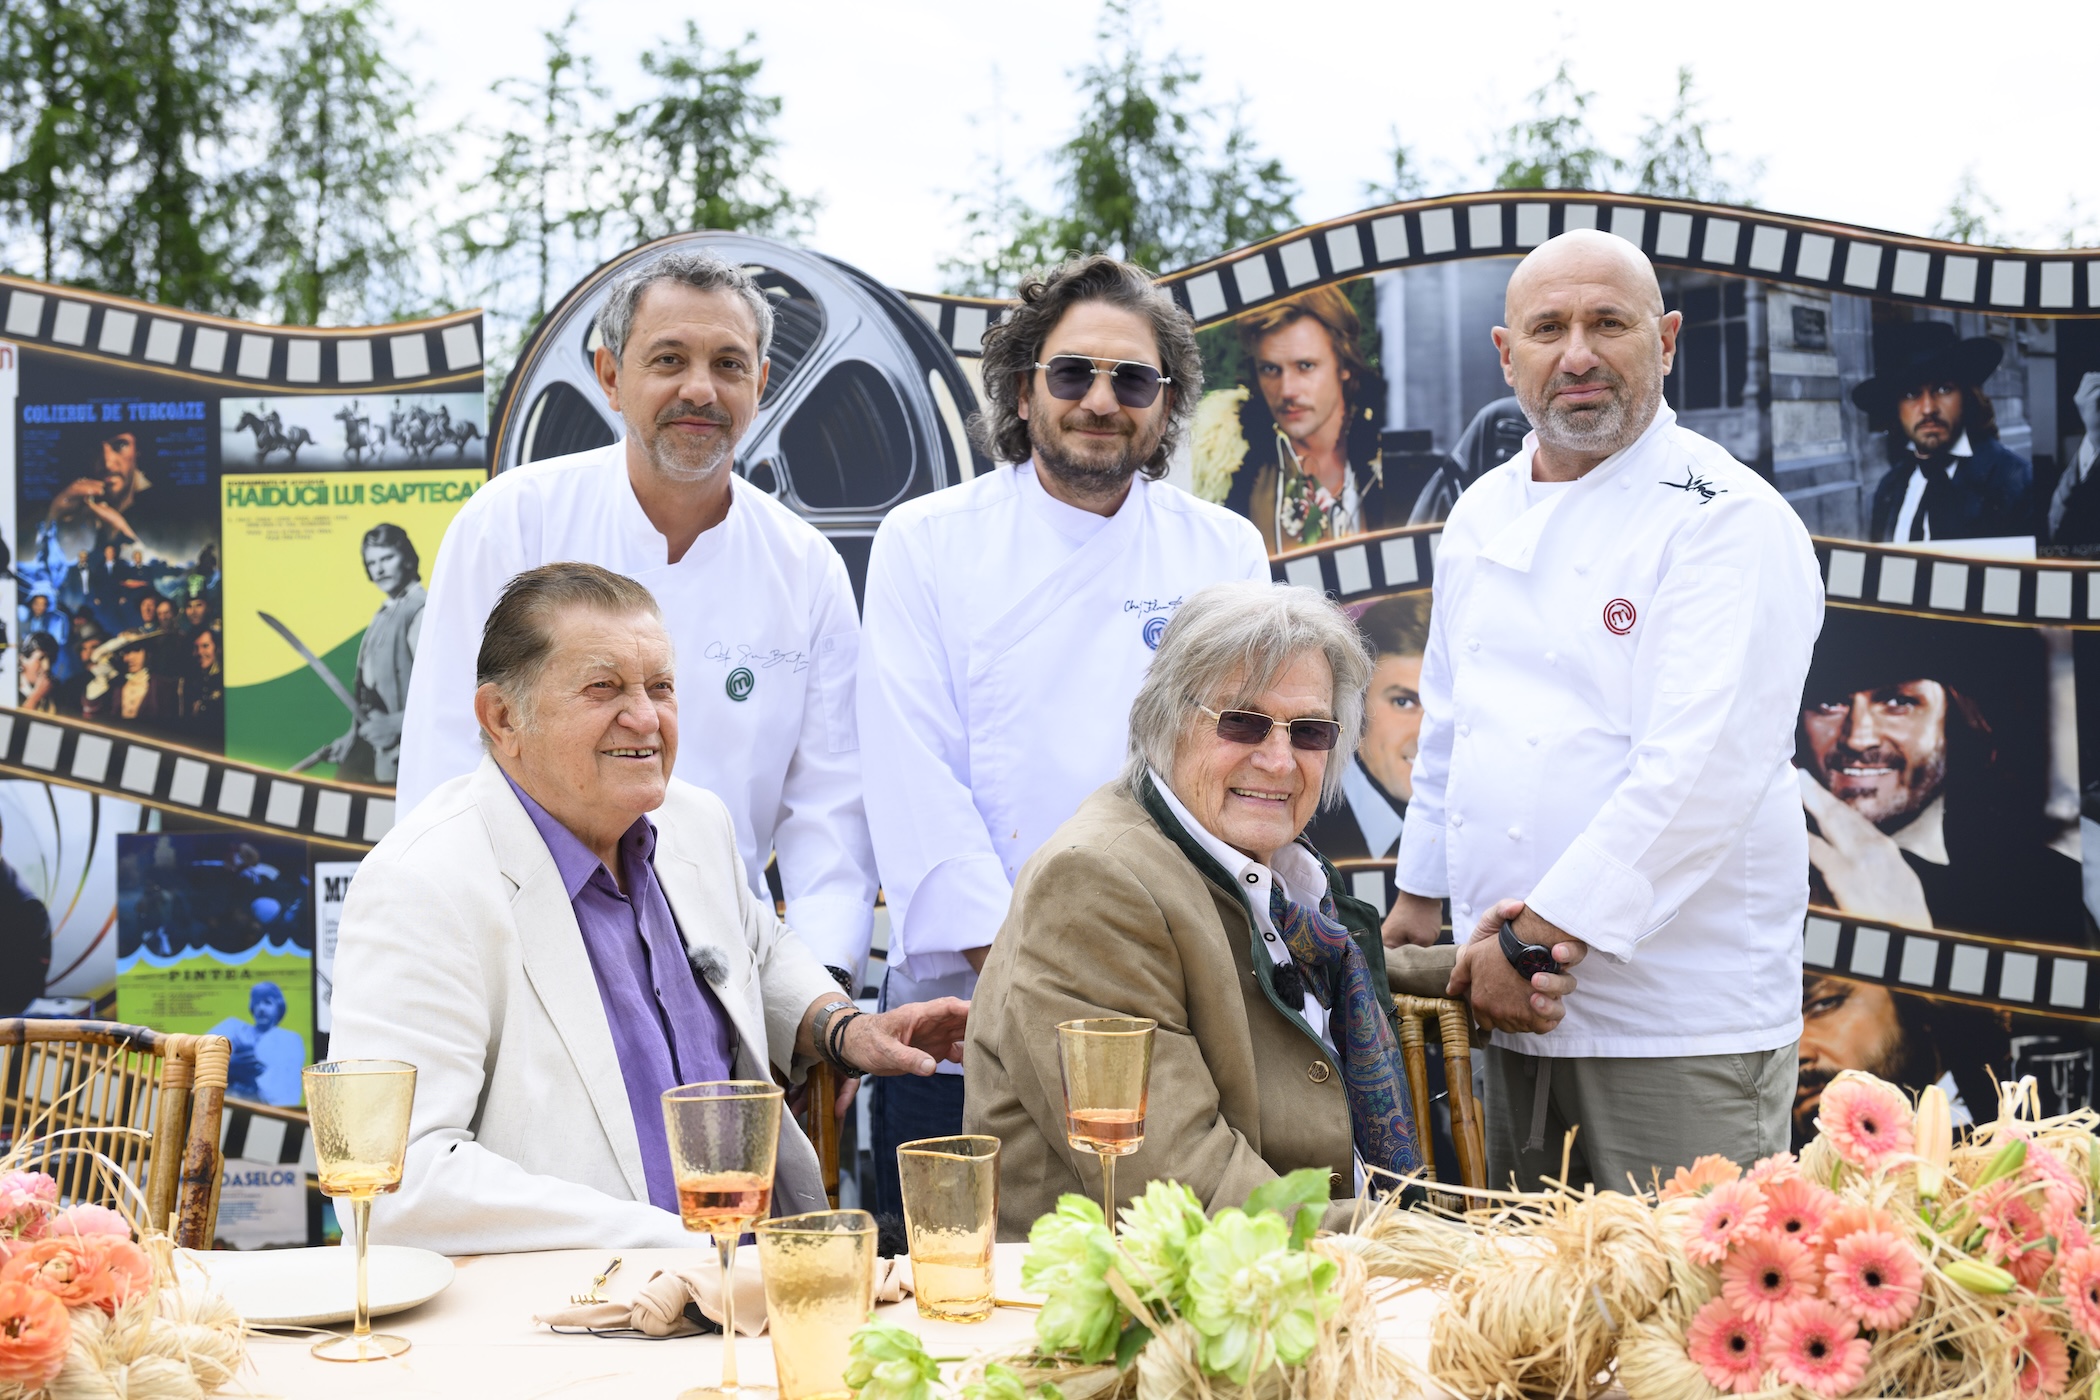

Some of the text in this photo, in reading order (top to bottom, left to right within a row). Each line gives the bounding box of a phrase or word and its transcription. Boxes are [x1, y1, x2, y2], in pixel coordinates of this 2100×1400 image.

[23, 401, 206, 423] COLIERUL DE TURCOAZE
[227, 481, 481, 507] HAIDUCII LUI SAPTECA
[168, 969, 251, 981] PINTEA
